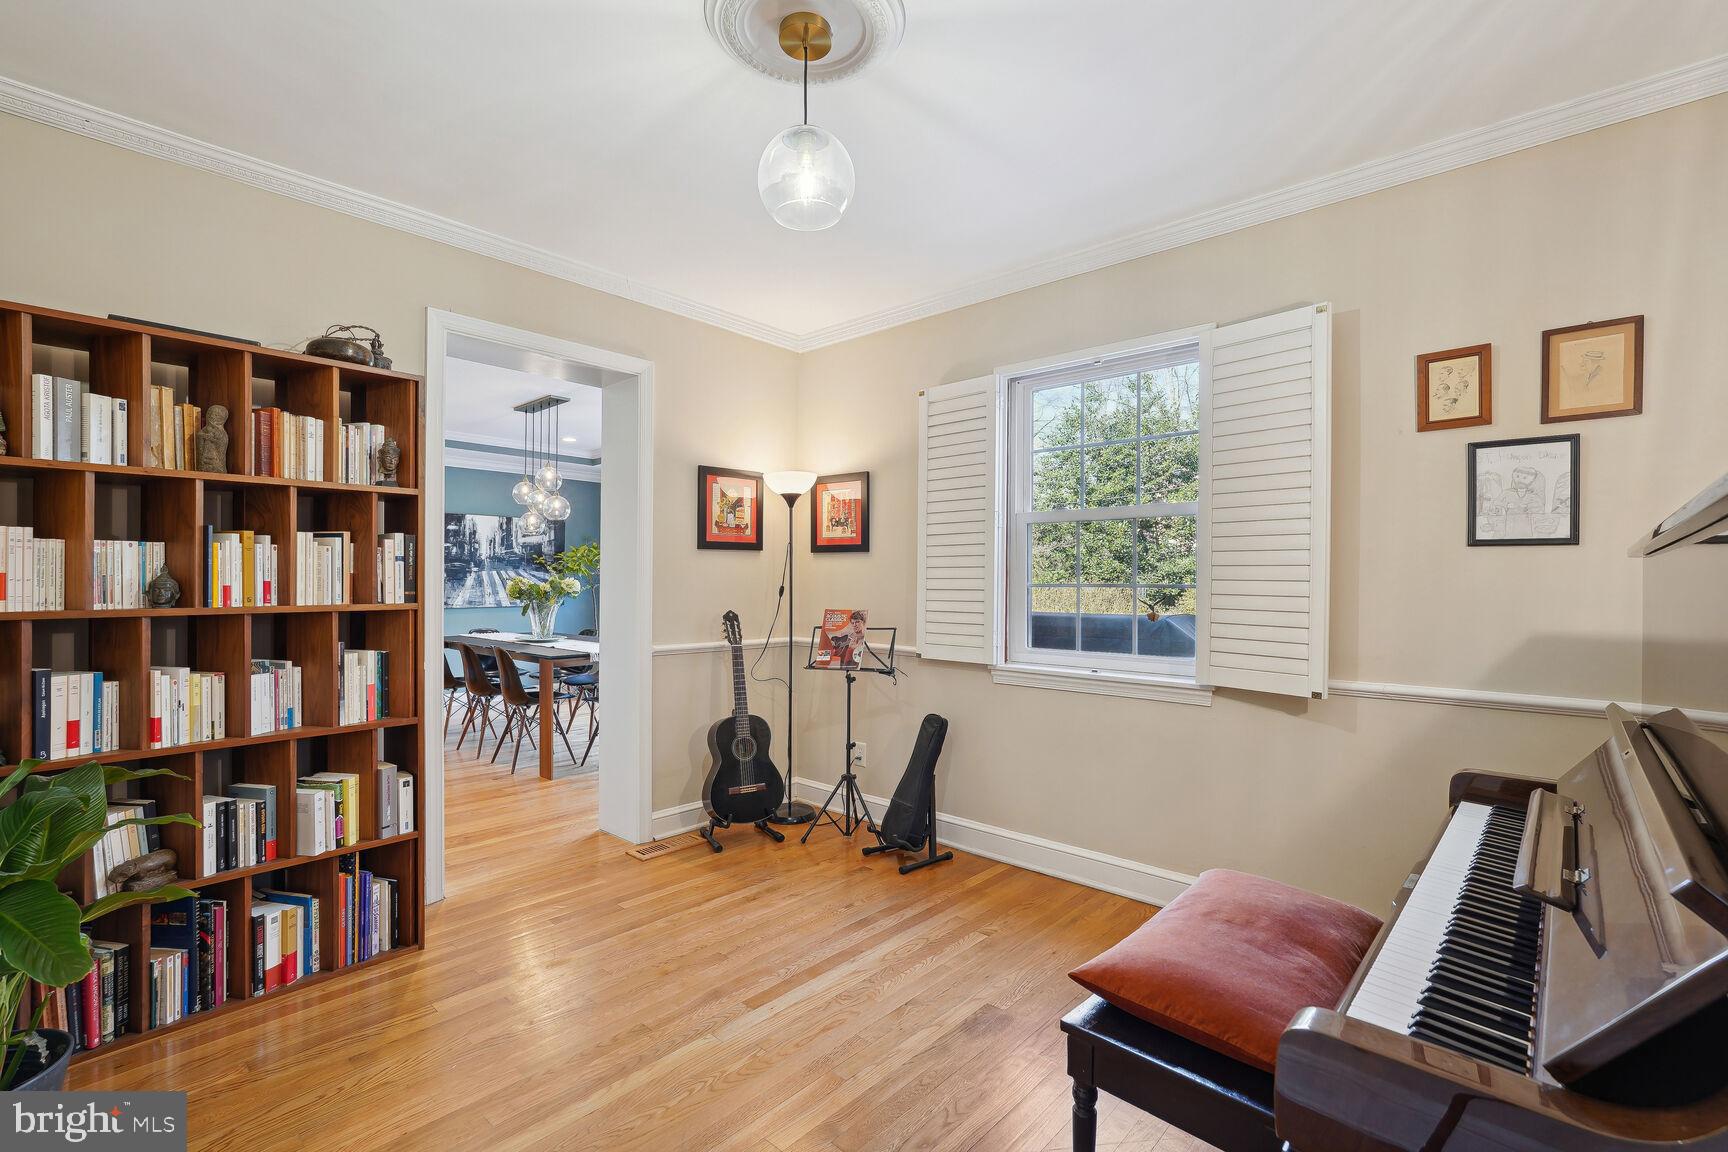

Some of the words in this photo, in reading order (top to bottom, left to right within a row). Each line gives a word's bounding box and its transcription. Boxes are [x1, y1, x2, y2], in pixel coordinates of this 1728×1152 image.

[43, 376, 51, 401] KRISTOF
[65, 383, 73, 407] AUSTER
[43, 401, 51, 421] AGOTA
[65, 407, 73, 423] PAUL
